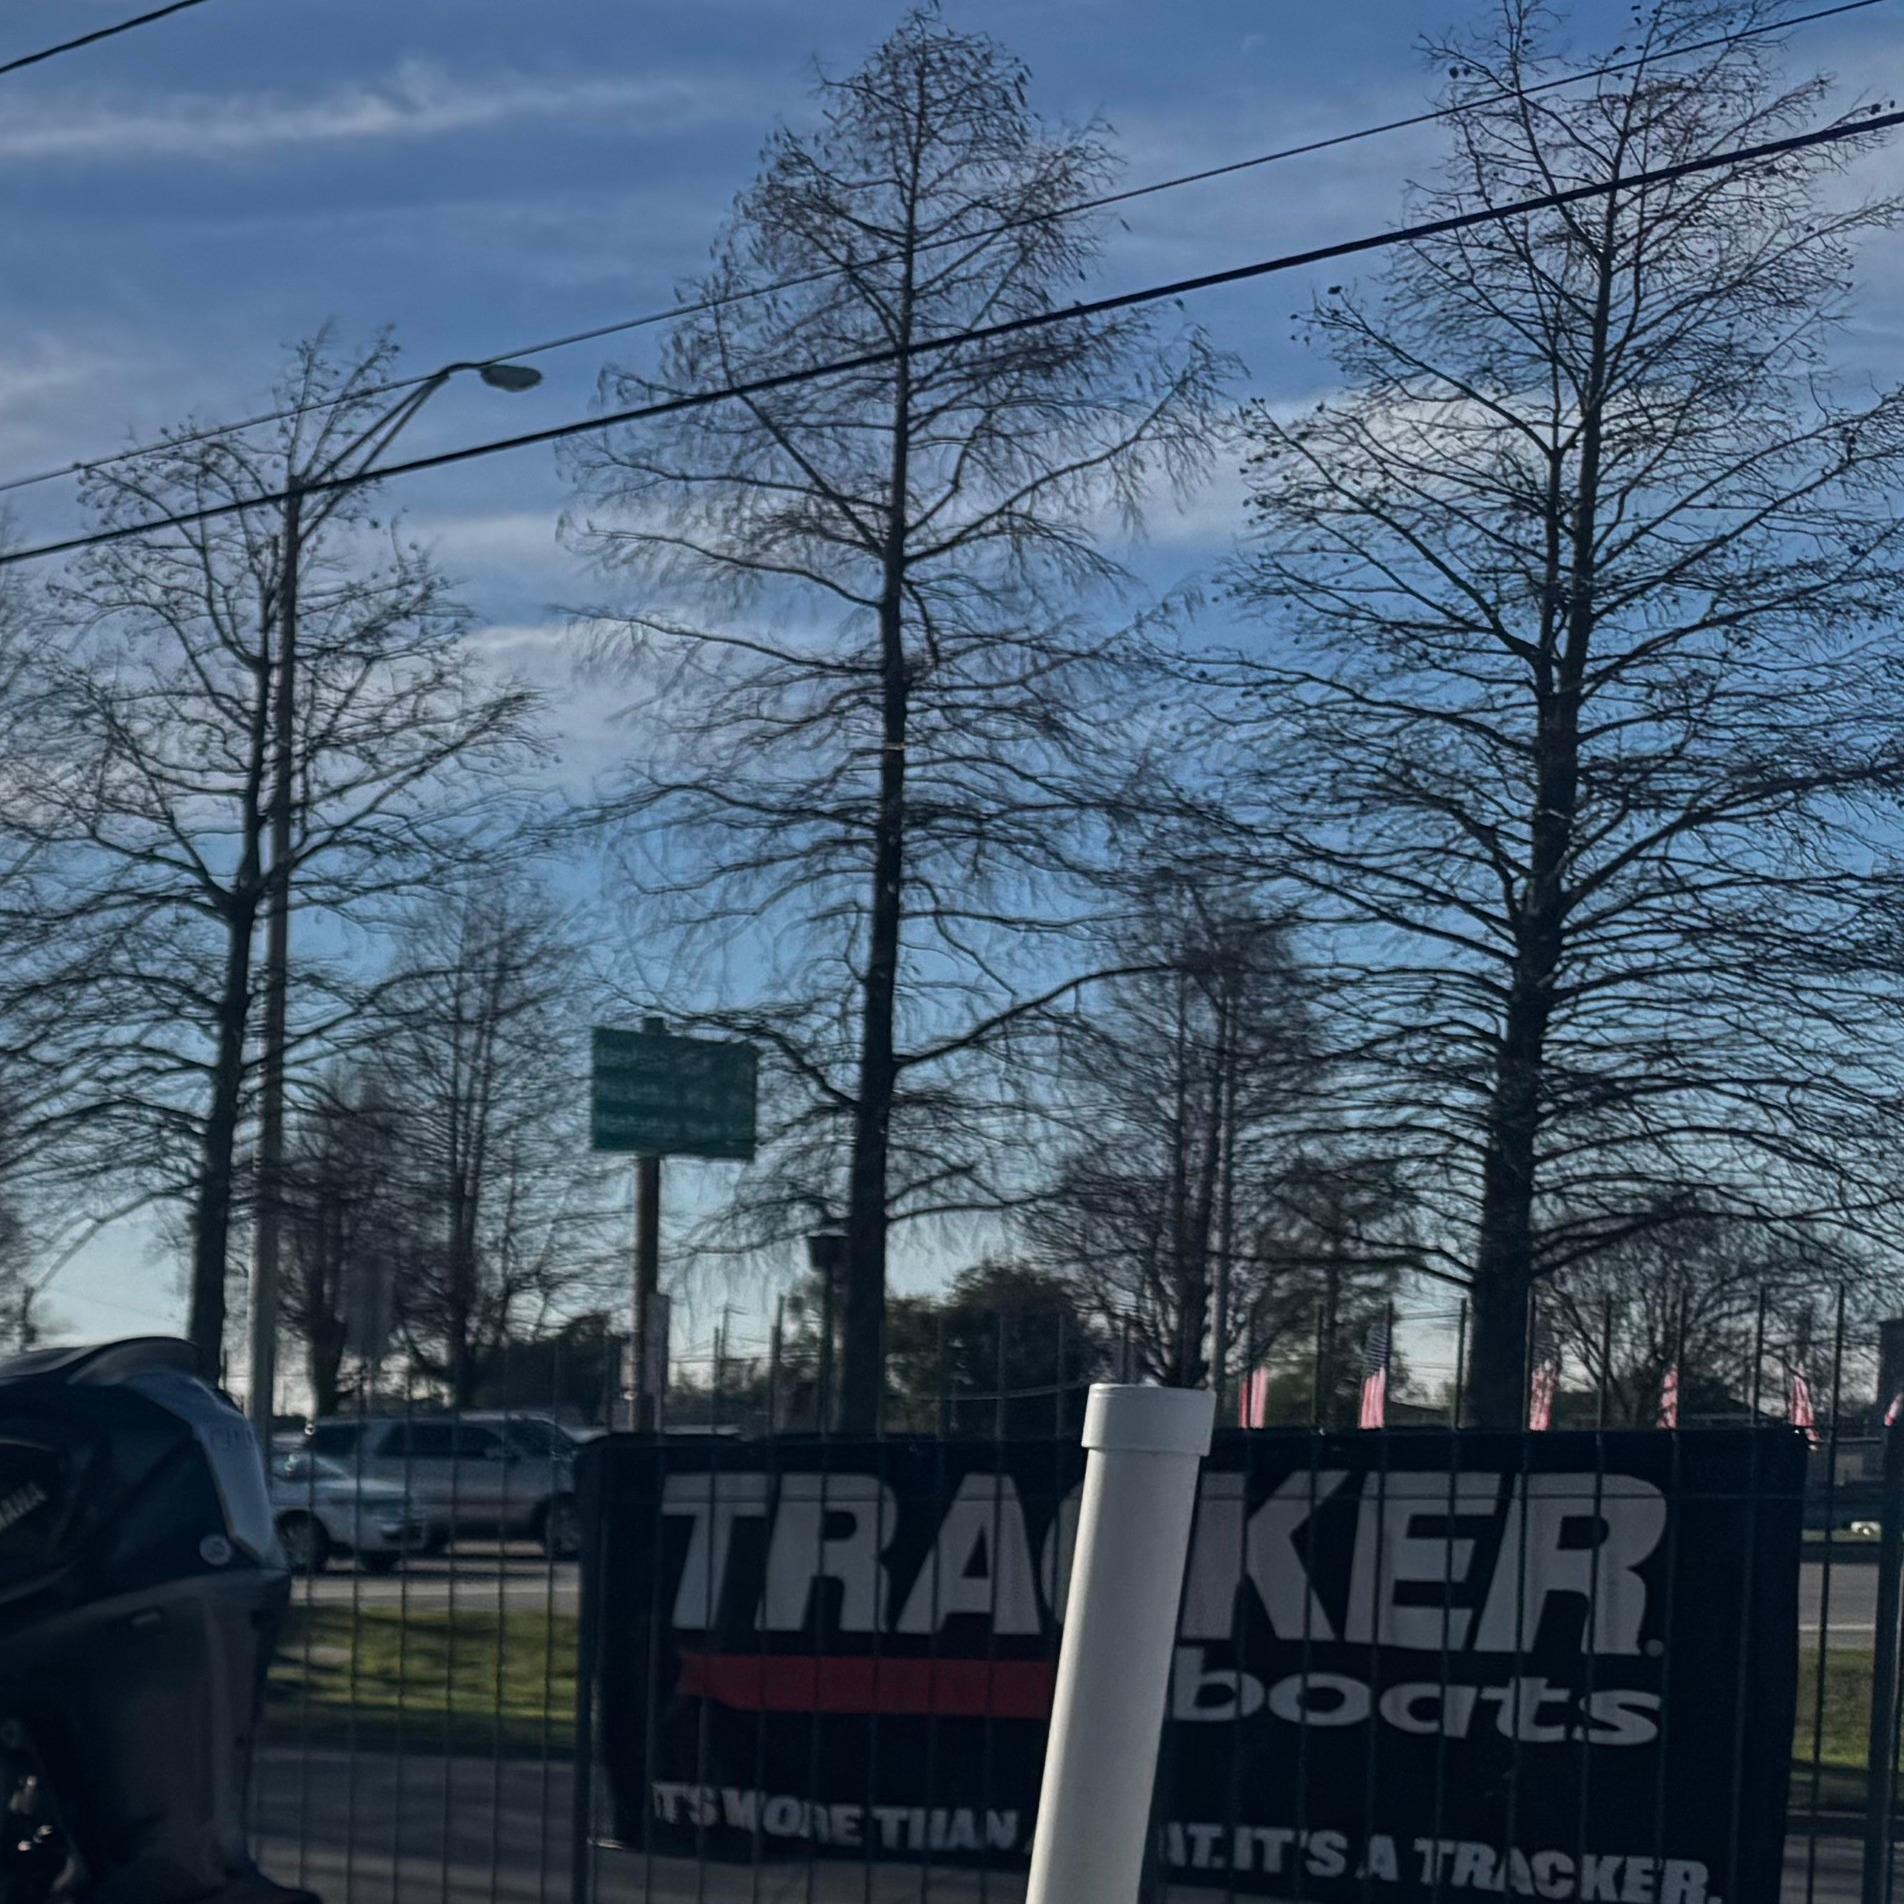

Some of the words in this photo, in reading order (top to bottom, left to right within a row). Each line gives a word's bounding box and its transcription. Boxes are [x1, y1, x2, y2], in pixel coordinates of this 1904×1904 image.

[660, 1471, 1667, 1657] TRAKER
[1169, 1647, 1662, 1746] boats
[873, 1805, 1018, 1851] THAN
[1233, 1825, 1349, 1878] IT'S
[1353, 1834, 1400, 1882] A
